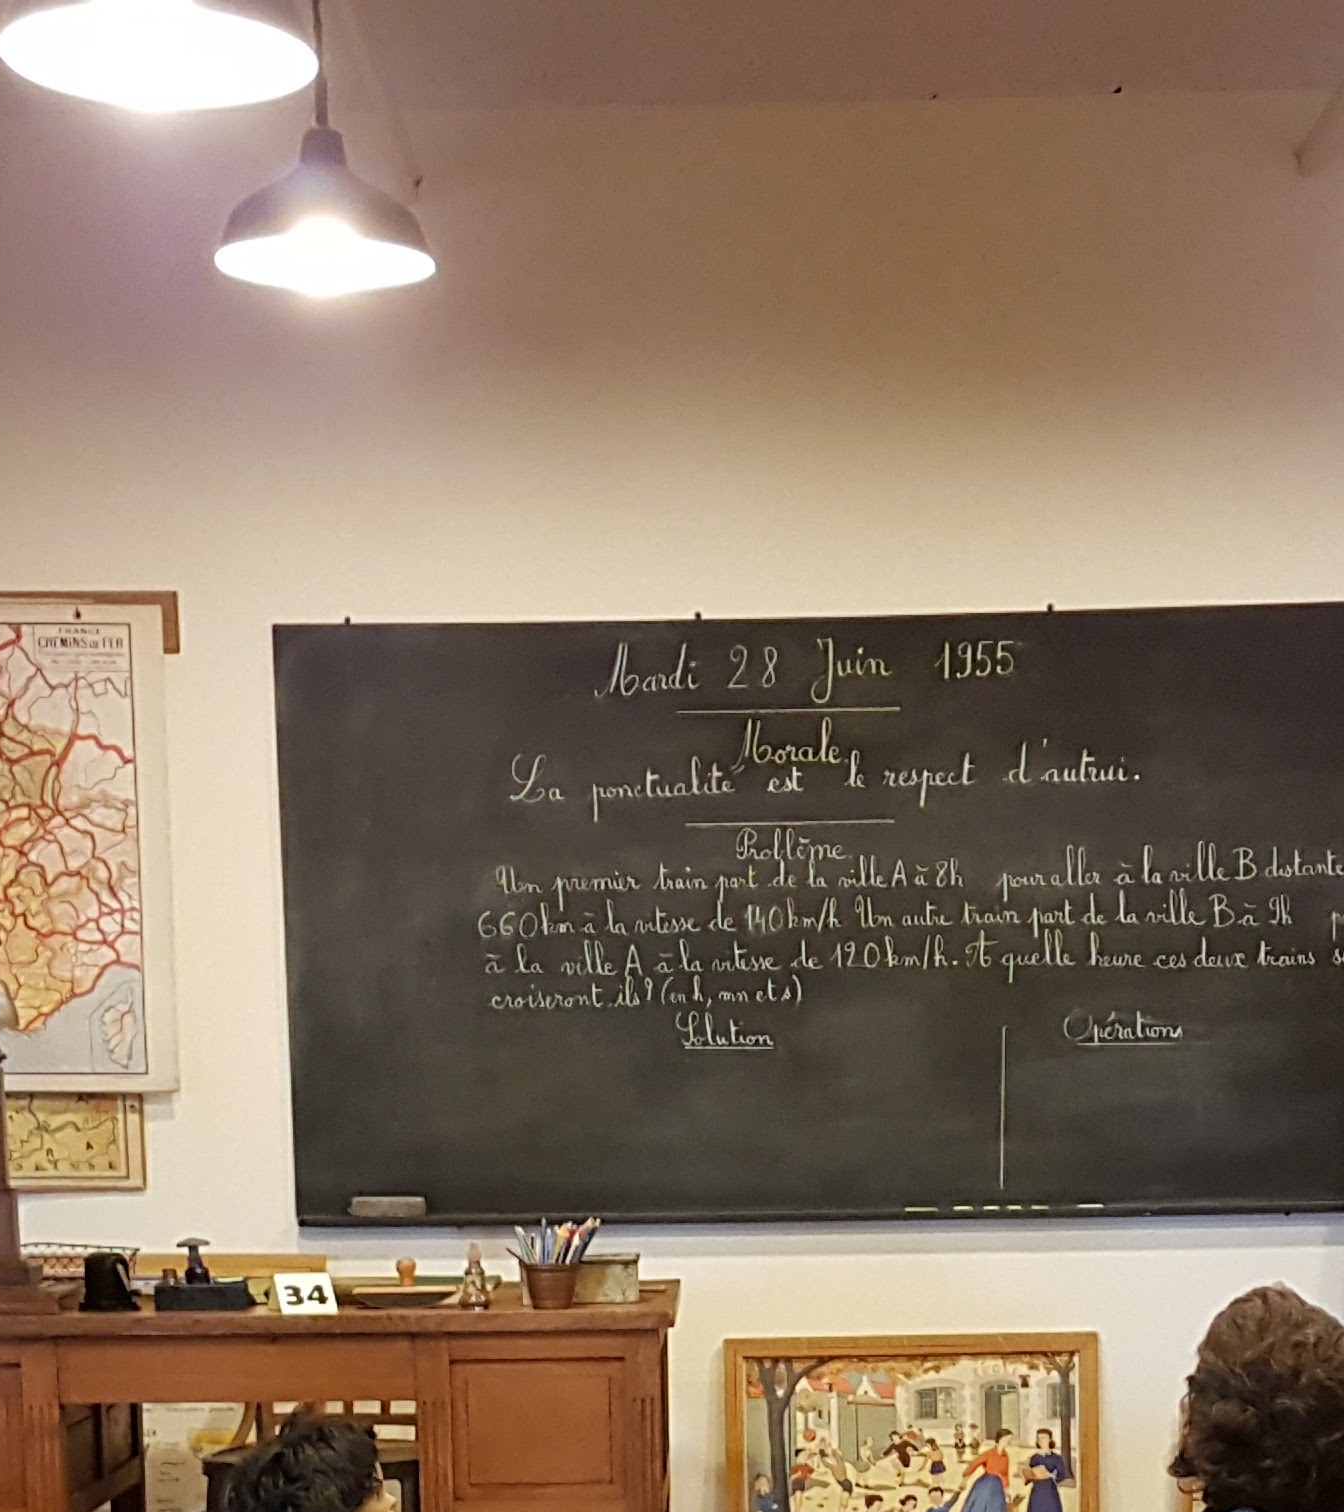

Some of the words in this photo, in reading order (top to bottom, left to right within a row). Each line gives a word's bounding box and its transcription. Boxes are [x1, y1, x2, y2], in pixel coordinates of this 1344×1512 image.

[38, 637, 87, 648] CHEMINS
[594, 641, 701, 698] Mardi
[727, 645, 779, 690] 28
[812, 637, 893, 704] Juin
[934, 640, 1017, 680] 1955
[508, 753, 565, 801] La
[591, 755, 745, 823] ponctualité
[766, 767, 805, 793] est
[848, 750, 867, 788] le
[882, 752, 976, 807] respect
[495, 865, 542, 894] Un
[552, 870, 642, 911] premier
[654, 862, 708, 892] train
[715, 865, 759, 900] part
[768, 859, 797, 888] de
[807, 861, 828, 888] la
[838, 855, 888, 889] ville
[891, 859, 907, 887] A
[914, 864, 930, 886] à
[996, 871, 1046, 902] pour
[1050, 844, 1103, 887] aller
[1112, 862, 1136, 885] à
[1141, 844, 1164, 885] la
[1168, 840, 1231, 882] ville
[1232, 847, 1258, 881] B
[582, 912, 598, 935] à
[605, 899, 629, 936] la
[633, 905, 701, 933] vitesse
[707, 900, 737, 932] de
[854, 894, 895, 930] Un
[901, 901, 954, 927] autre
[960, 901, 1022, 926] train
[1027, 898, 1075, 939] part
[1081, 892, 1108, 925] de
[1114, 888, 1139, 926] la
[1144, 887, 1206, 927] ville
[1208, 893, 1235, 928] B
[1239, 903, 1261, 926] à
[484, 952, 505, 974] à
[514, 943, 544, 975] la
[560, 940, 618, 976] ville
[624, 944, 644, 977] A
[656, 952, 675, 974] à
[678, 939, 704, 973] la
[711, 940, 782, 972] vitesse
[789, 939, 824, 971] de
[1000, 928, 1077, 984] quelle
[1088, 931, 1147, 968] heure
[1152, 951, 1187, 970] ces
[1193, 936, 1251, 969] deux
[1256, 940, 1316, 968] trains
[675, 1010, 775, 1047] Solution
[1063, 1009, 1185, 1044] Opérations
[283, 1284, 329, 1306] 34
